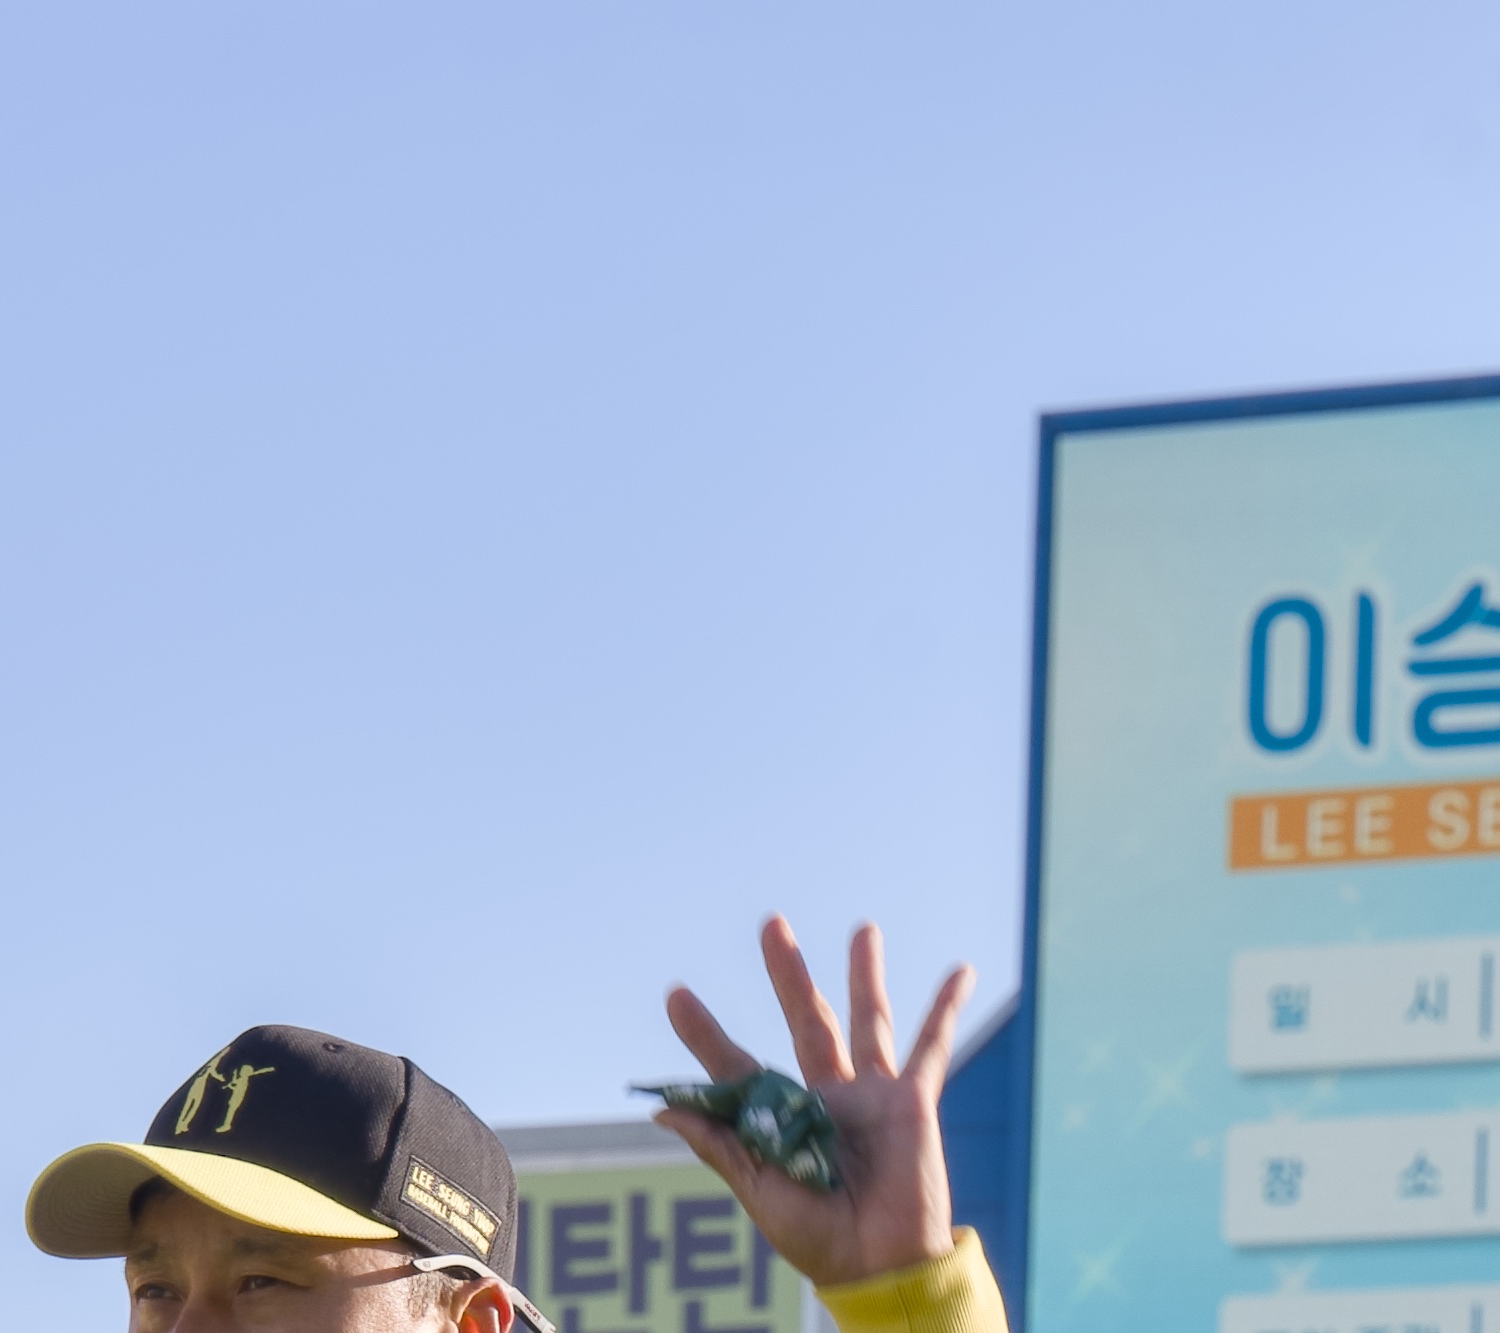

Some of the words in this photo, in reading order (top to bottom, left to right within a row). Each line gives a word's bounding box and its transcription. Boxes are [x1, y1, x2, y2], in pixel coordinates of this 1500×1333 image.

[1259, 796, 1397, 862] LEE
[412, 1166, 435, 1191] LEE
[438, 1183, 471, 1216] SEUNG
